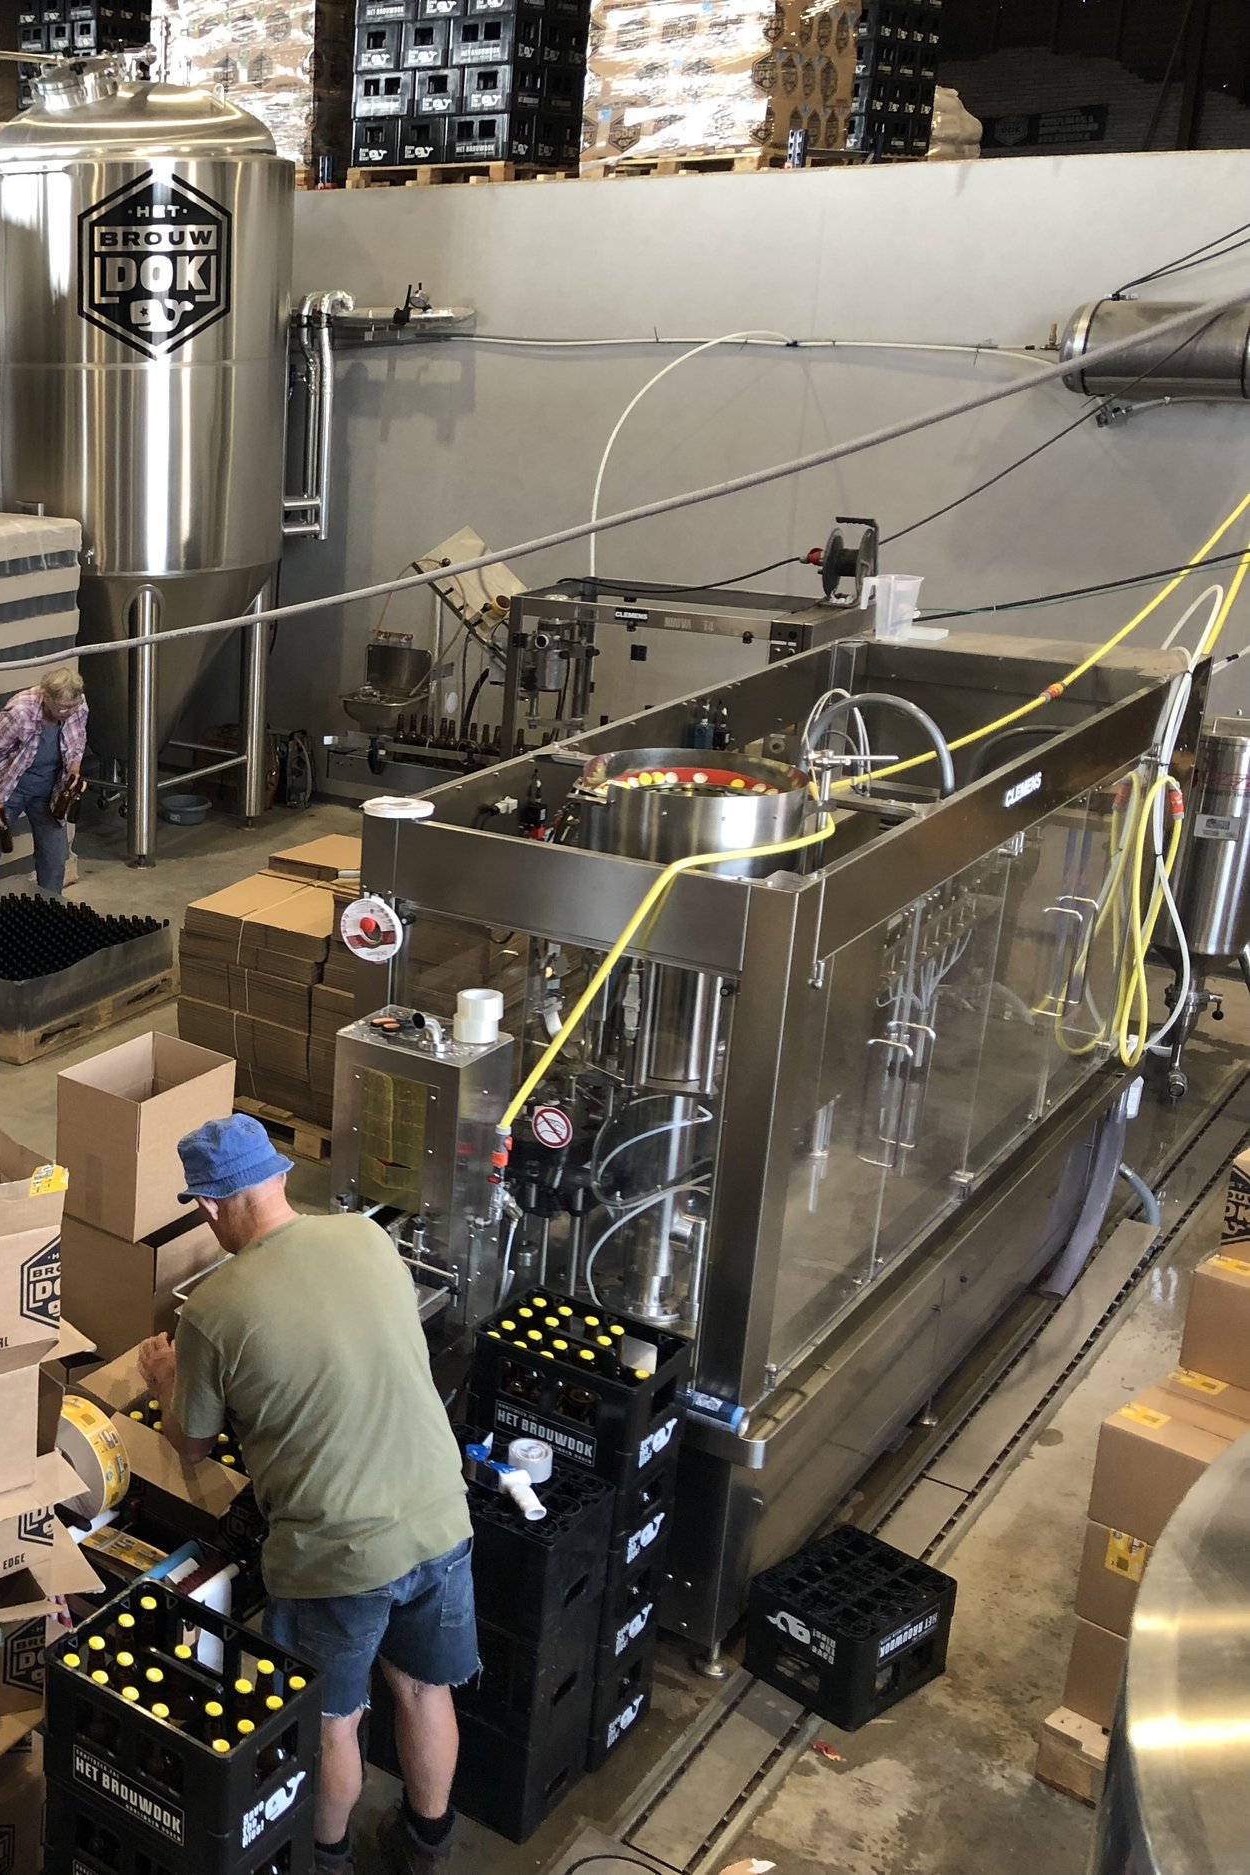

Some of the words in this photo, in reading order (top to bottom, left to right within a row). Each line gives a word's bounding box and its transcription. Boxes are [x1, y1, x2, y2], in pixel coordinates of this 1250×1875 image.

[99, 230, 213, 247] BROUW
[105, 254, 208, 293] DOK
[497, 1409, 518, 1427] HET
[521, 1419, 594, 1458] BROUWDOK
[3, 1552, 26, 1570] EDGE
[75, 1756, 99, 1782] HET
[102, 1773, 181, 1834] BROUWDOK
